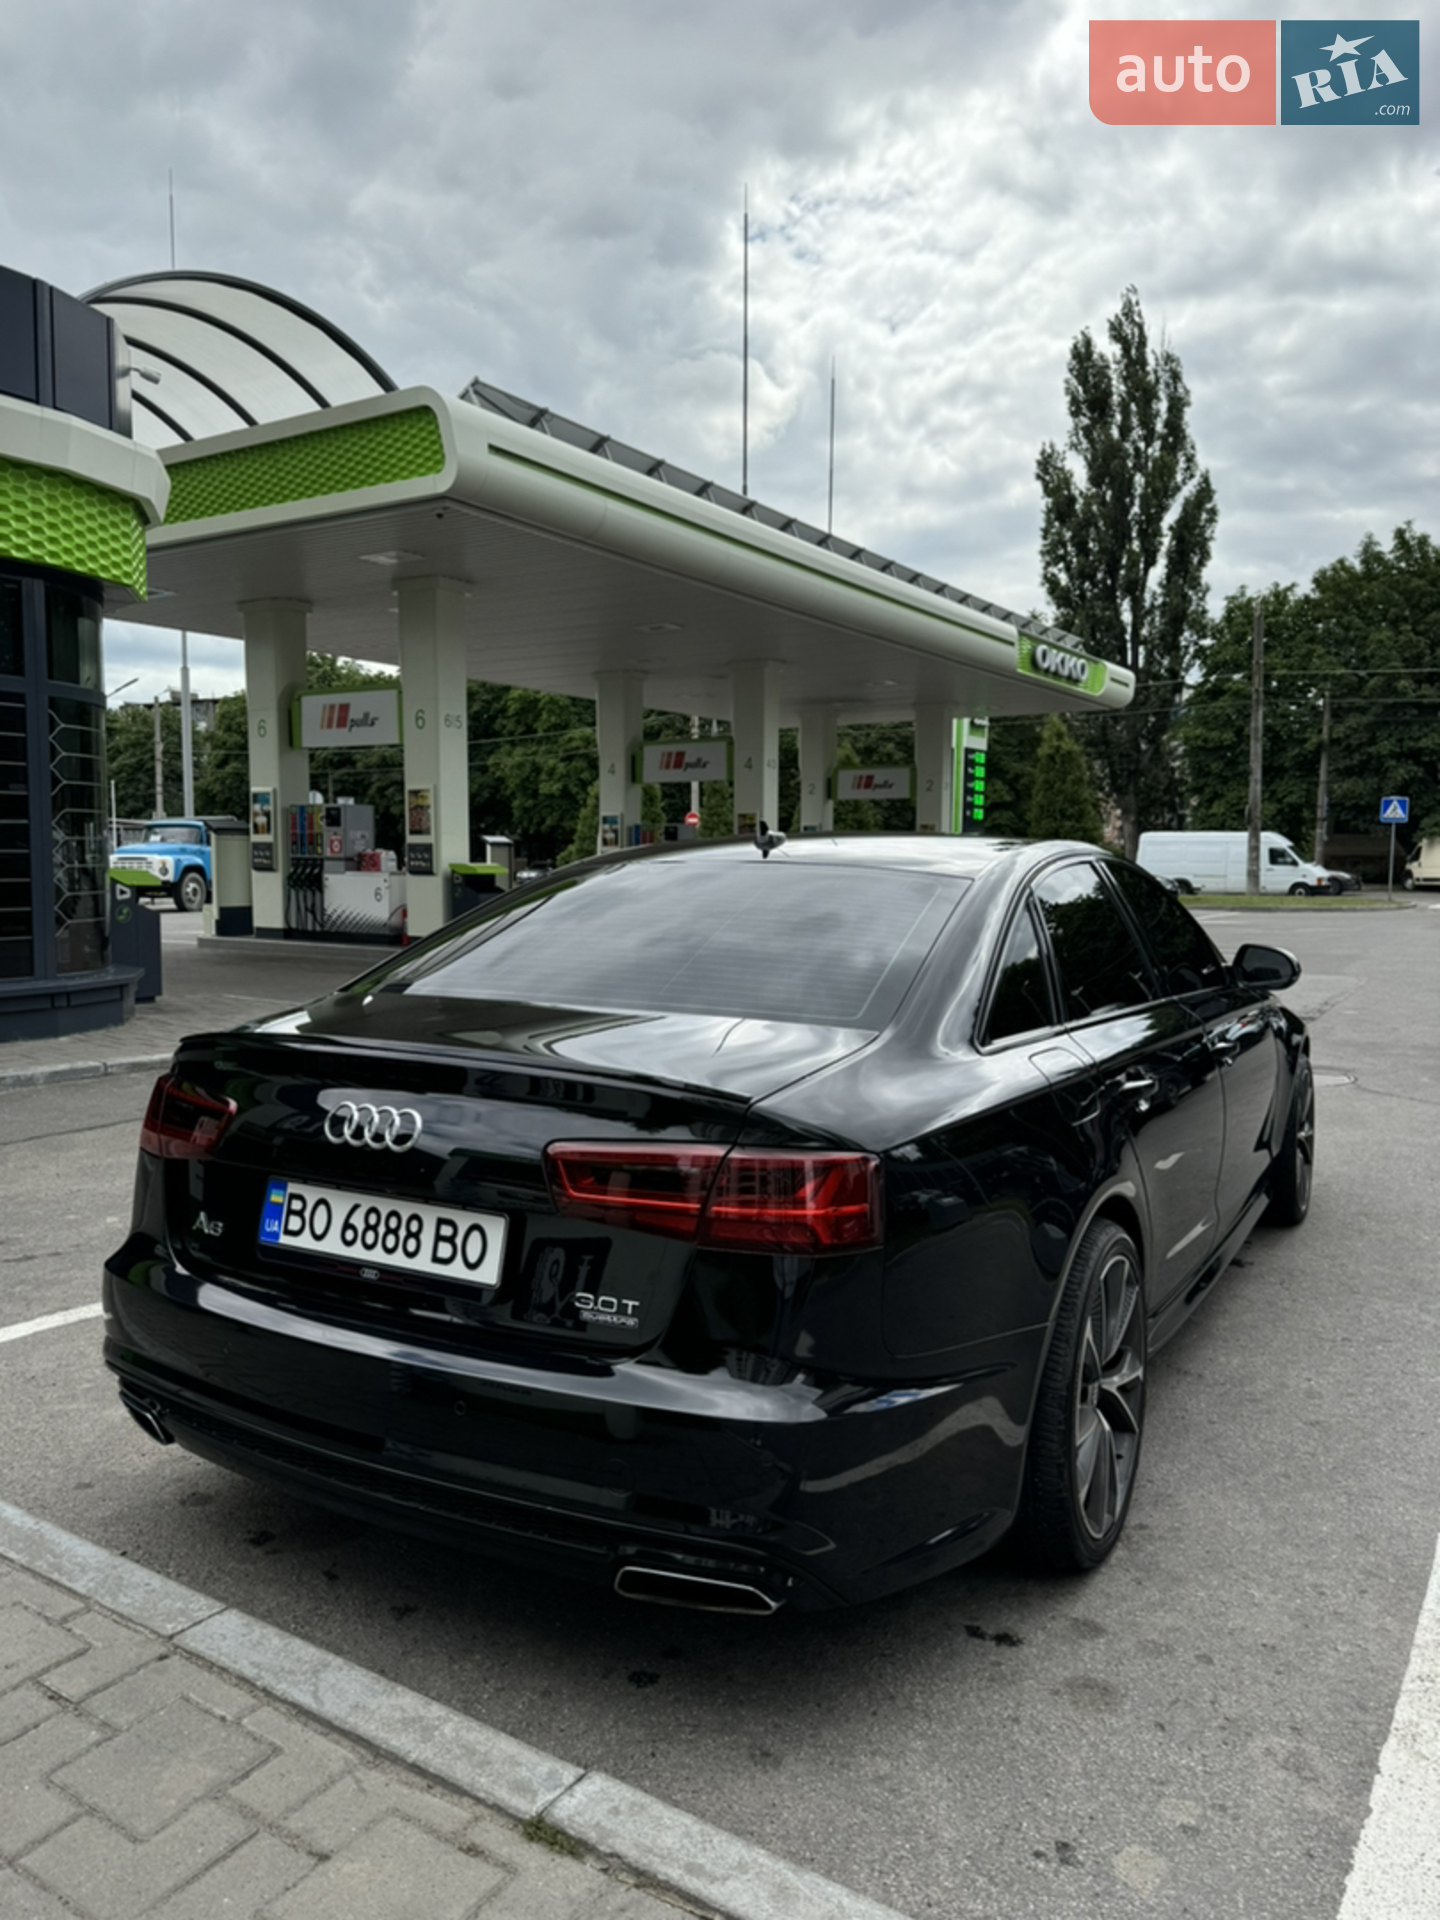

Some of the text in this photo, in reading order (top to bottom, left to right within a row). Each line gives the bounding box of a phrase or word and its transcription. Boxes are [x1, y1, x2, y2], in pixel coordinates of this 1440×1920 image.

[1035, 644, 1089, 682] OKKO
[348, 711, 379, 733] pulls
[415, 708, 426, 730] 6
[257, 719, 268, 738] 6
[607, 762, 616, 776] 4
[744, 757, 753, 770] 4
[808, 783, 816, 795] 2
[925, 779, 934, 792] 2
[374, 887, 383, 902] 6
[192, 1210, 224, 1237] A6
[264, 1218, 279, 1233] UA
[282, 1192, 488, 1271] BO 6888 BO
